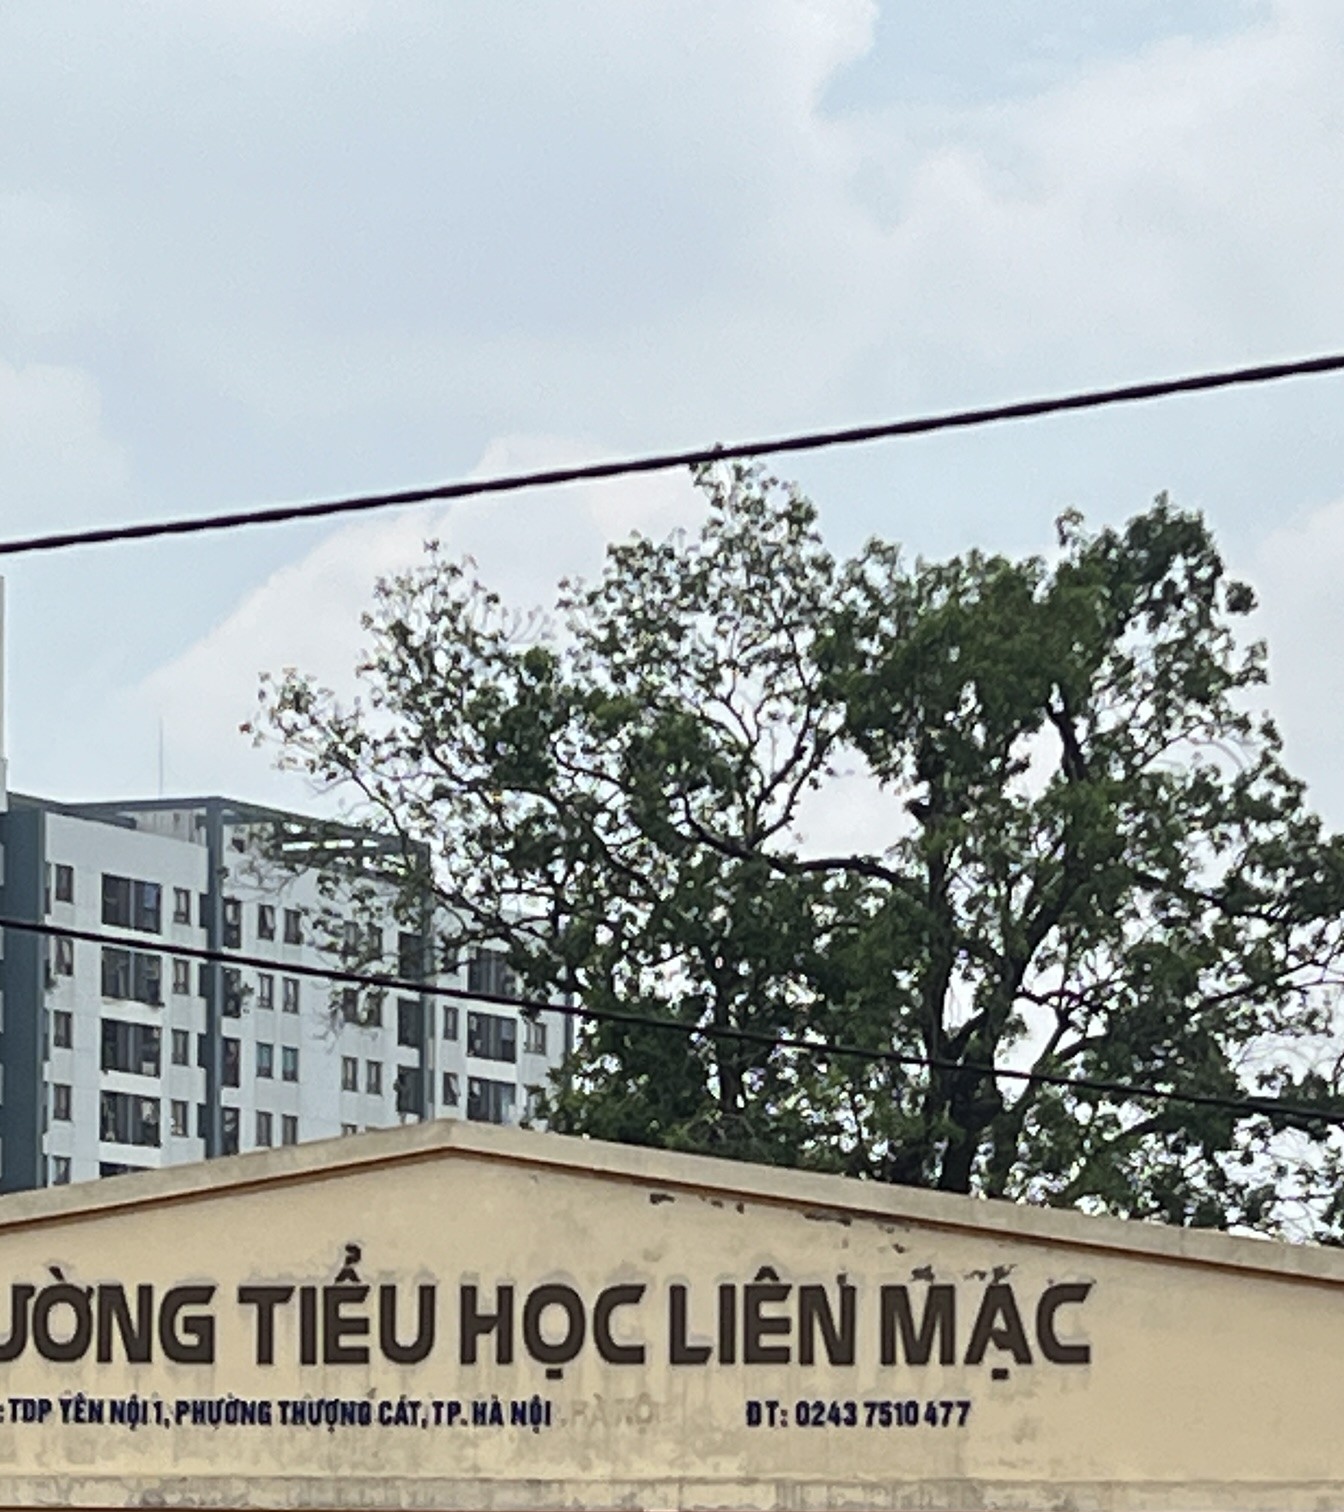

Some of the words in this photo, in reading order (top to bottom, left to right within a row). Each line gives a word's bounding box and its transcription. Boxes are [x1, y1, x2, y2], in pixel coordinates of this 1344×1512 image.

[237, 1244, 436, 1366] TIỂU
[459, 1282, 648, 1380] HỌC
[668, 1266, 857, 1366] LIÊN
[879, 1282, 1097, 1380] MẠC
[8, 1398, 53, 1424] TDP
[58, 1391, 105, 1425] YÊN
[109, 1393, 149, 1431] NỘI
[175, 1391, 273, 1427] PHƯỜNG
[277, 1397, 372, 1434] THƯỢNG
[377, 1394, 428, 1430] CÁT,
[432, 1400, 468, 1427] TP.
[472, 1393, 504, 1427] HÀ
[510, 1394, 551, 1434] NỘI
[795, 1400, 858, 1428] 0243
[862, 1400, 920, 1428] 7510
[924, 1400, 972, 1428] 477
